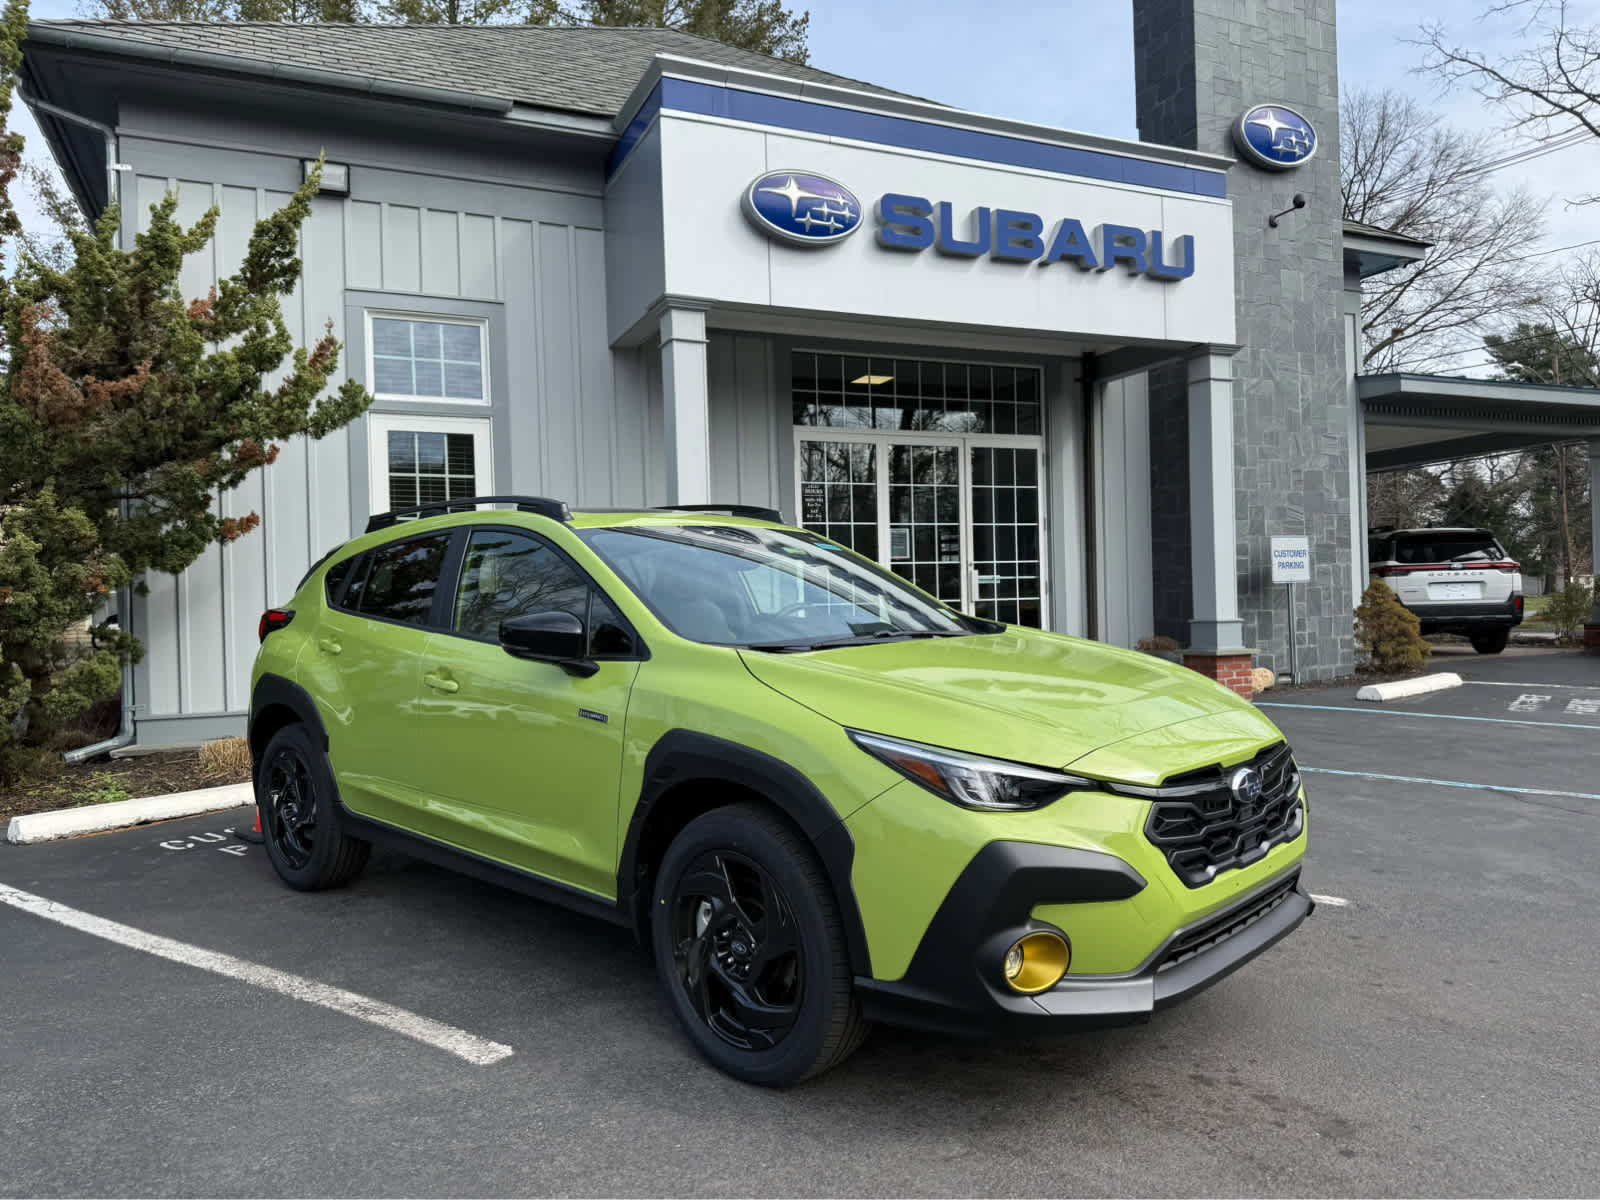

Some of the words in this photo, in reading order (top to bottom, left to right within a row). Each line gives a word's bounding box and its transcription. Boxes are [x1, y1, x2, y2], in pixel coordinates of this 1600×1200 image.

[878, 193, 1195, 281] SUBARU
[1274, 549, 1307, 558] CUSTOMER
[1278, 561, 1304, 569] PARKING
